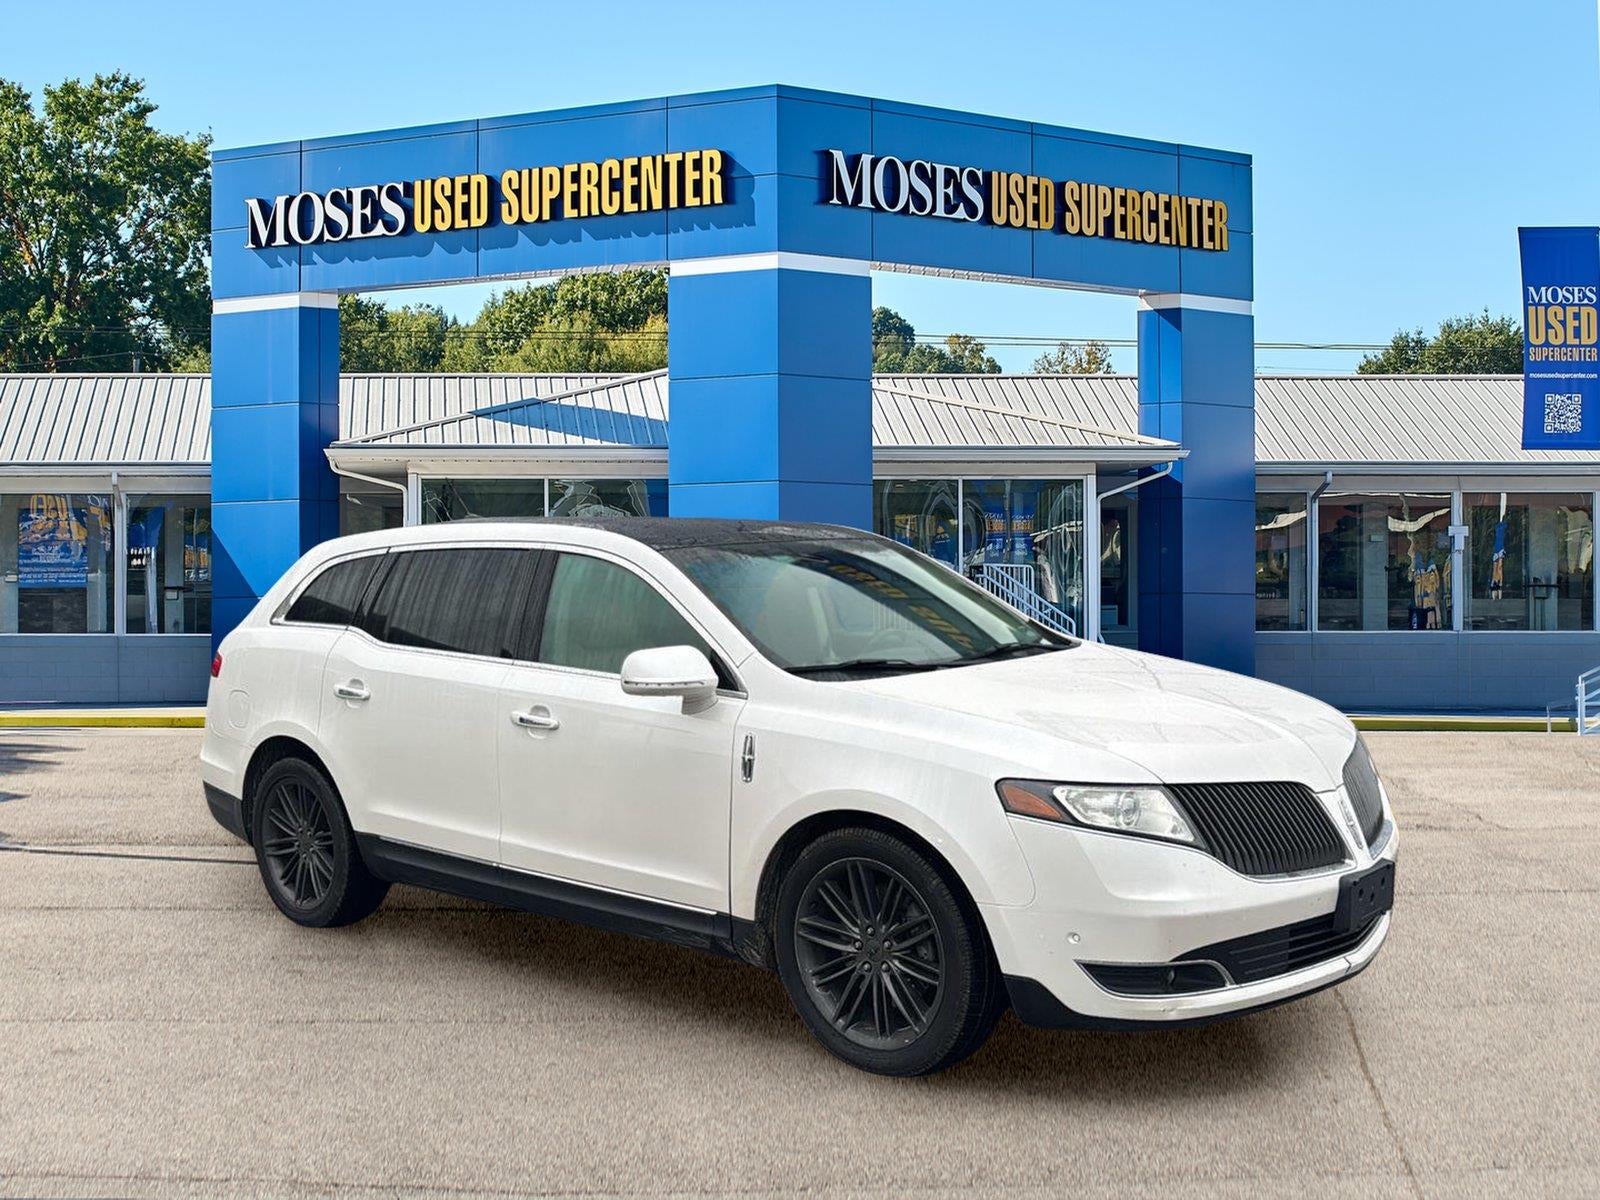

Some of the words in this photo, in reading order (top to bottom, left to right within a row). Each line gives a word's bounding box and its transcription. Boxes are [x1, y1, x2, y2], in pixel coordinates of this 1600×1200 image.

[245, 182, 407, 249] MOSES
[414, 173, 488, 233] USED
[500, 149, 724, 226] SUPERCENTER
[829, 149, 984, 222] MOSES
[991, 171, 1055, 230] USED
[1065, 180, 1229, 251] SUPERCENTER
[1527, 286, 1597, 304] MOSES
[1528, 306, 1598, 345] USED
[1529, 347, 1598, 362] SUPERCENTER
